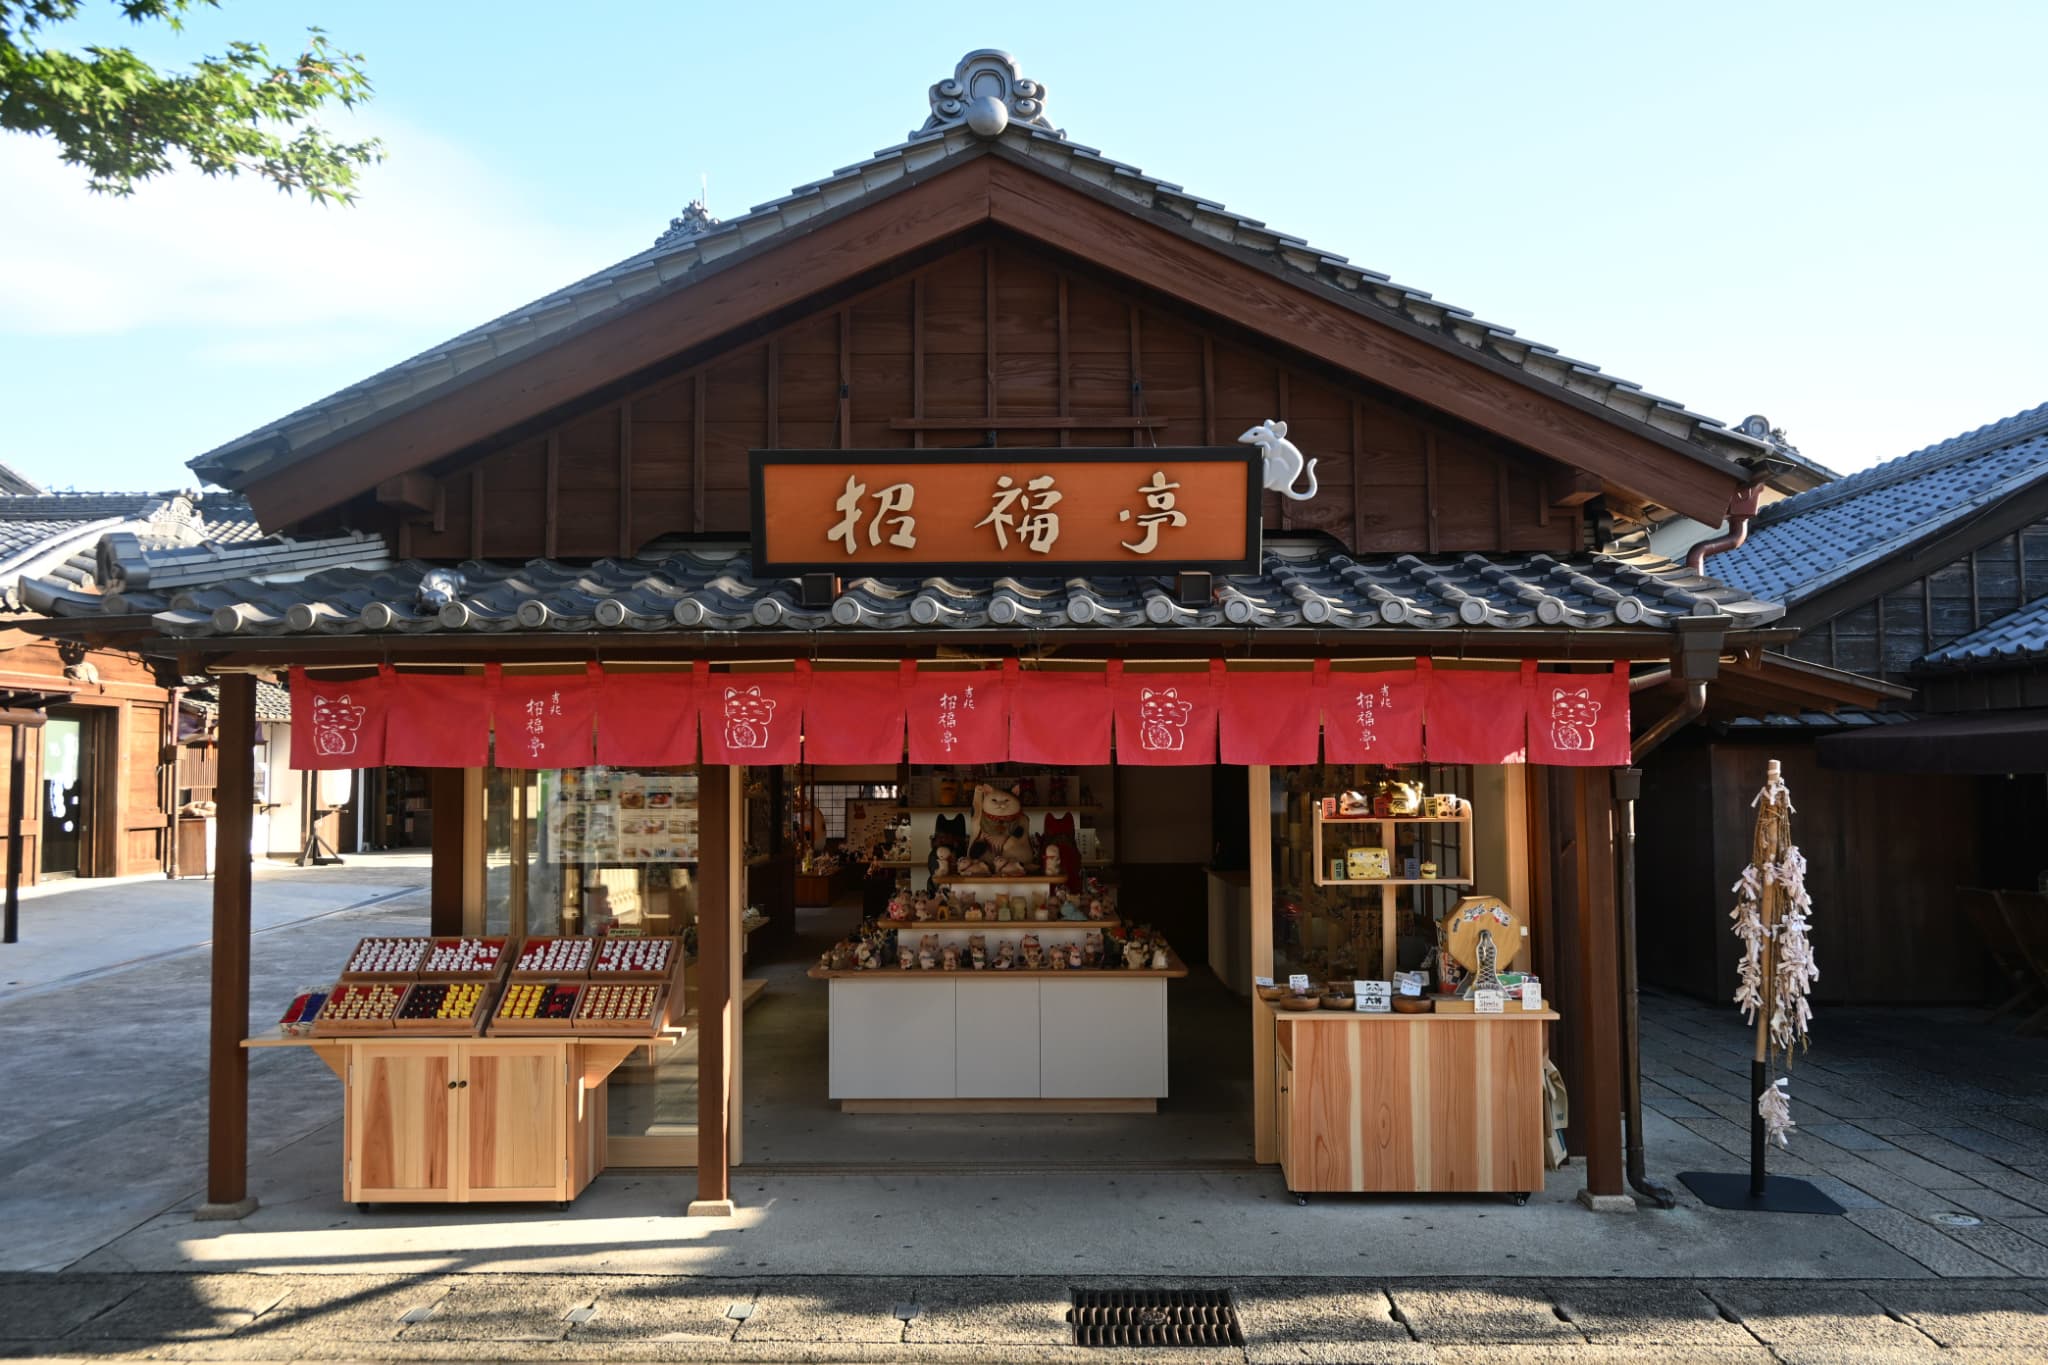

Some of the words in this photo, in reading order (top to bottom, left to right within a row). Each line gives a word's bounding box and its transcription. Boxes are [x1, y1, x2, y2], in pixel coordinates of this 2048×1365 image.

[828, 471, 1188, 555] 招福亭
[526, 698, 545, 757] 招福亭
[938, 693, 957, 752] 招福亭
[1356, 692, 1376, 750] 招福亭
